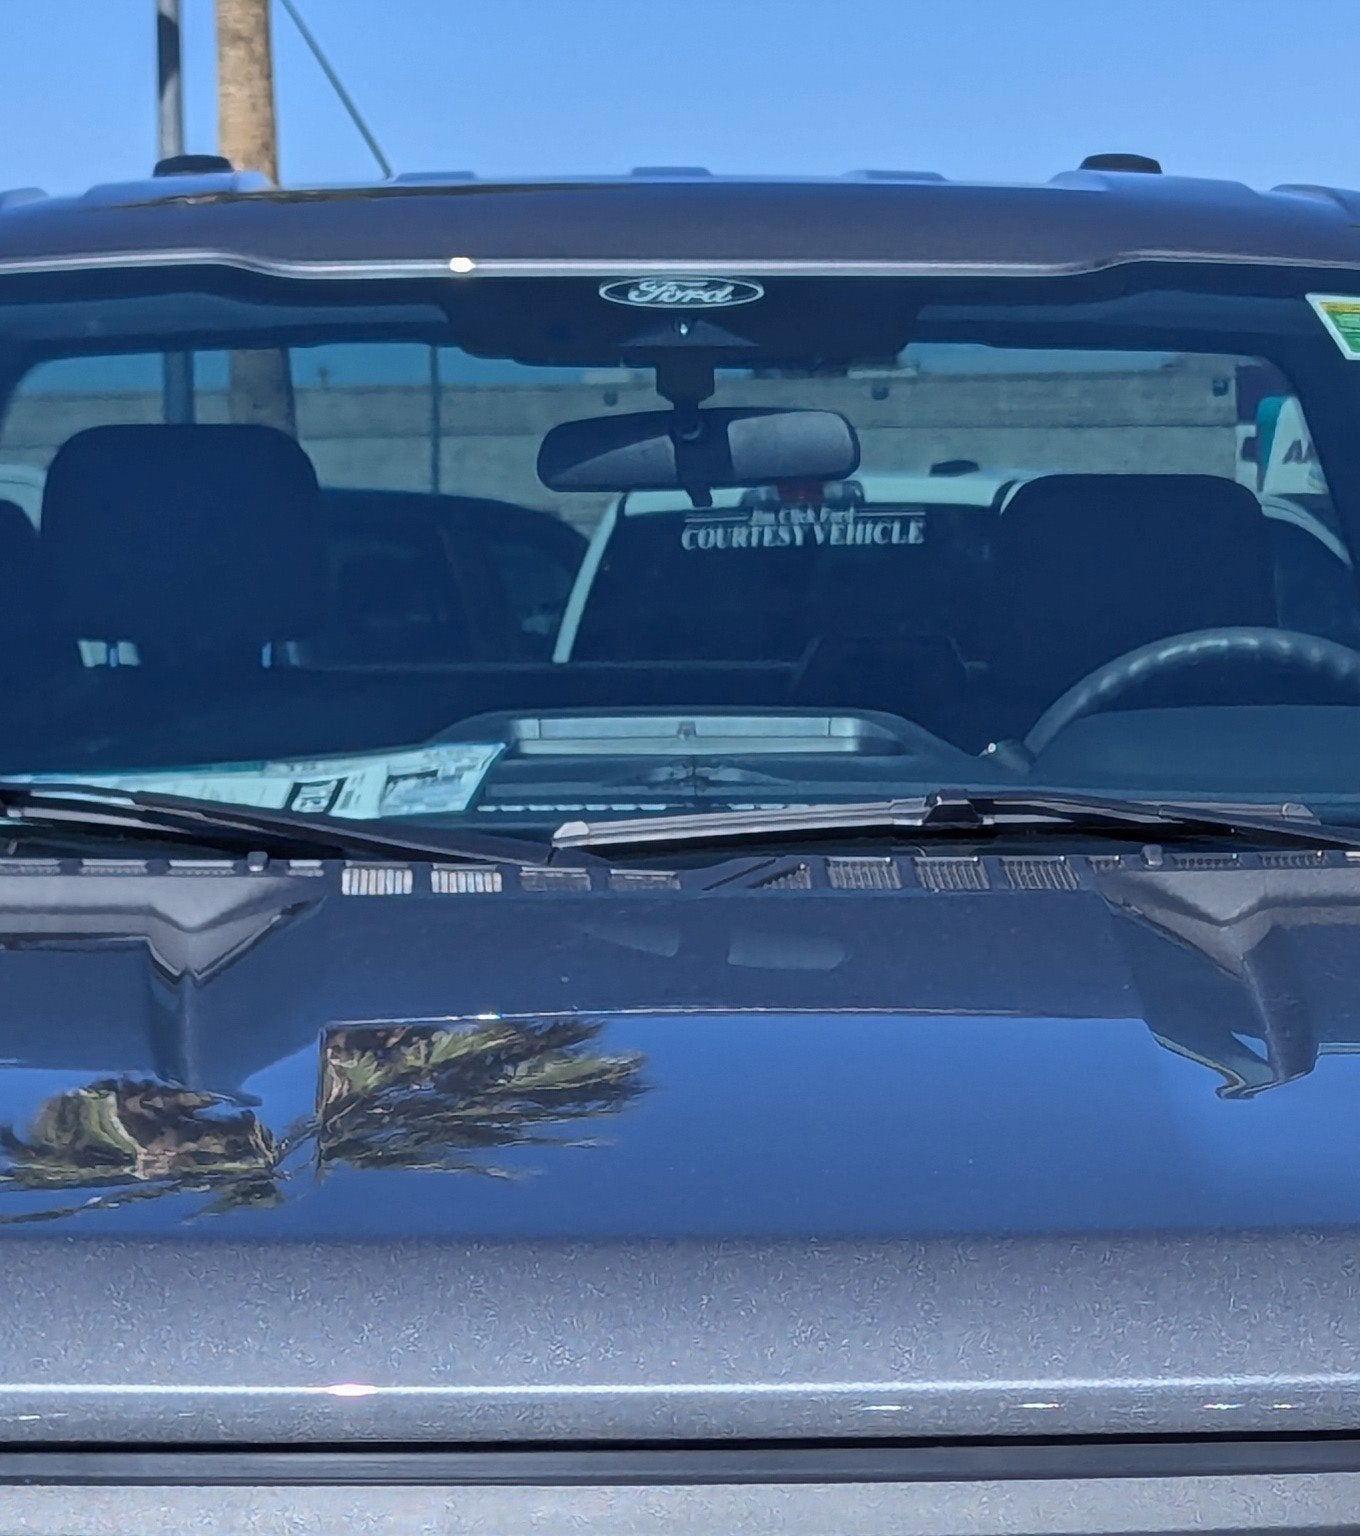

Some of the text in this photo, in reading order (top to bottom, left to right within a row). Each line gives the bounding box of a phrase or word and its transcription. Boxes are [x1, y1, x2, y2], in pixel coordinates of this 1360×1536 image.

[628, 279, 735, 303] Ford
[681, 518, 926, 551] COURTESY VEHICLE
